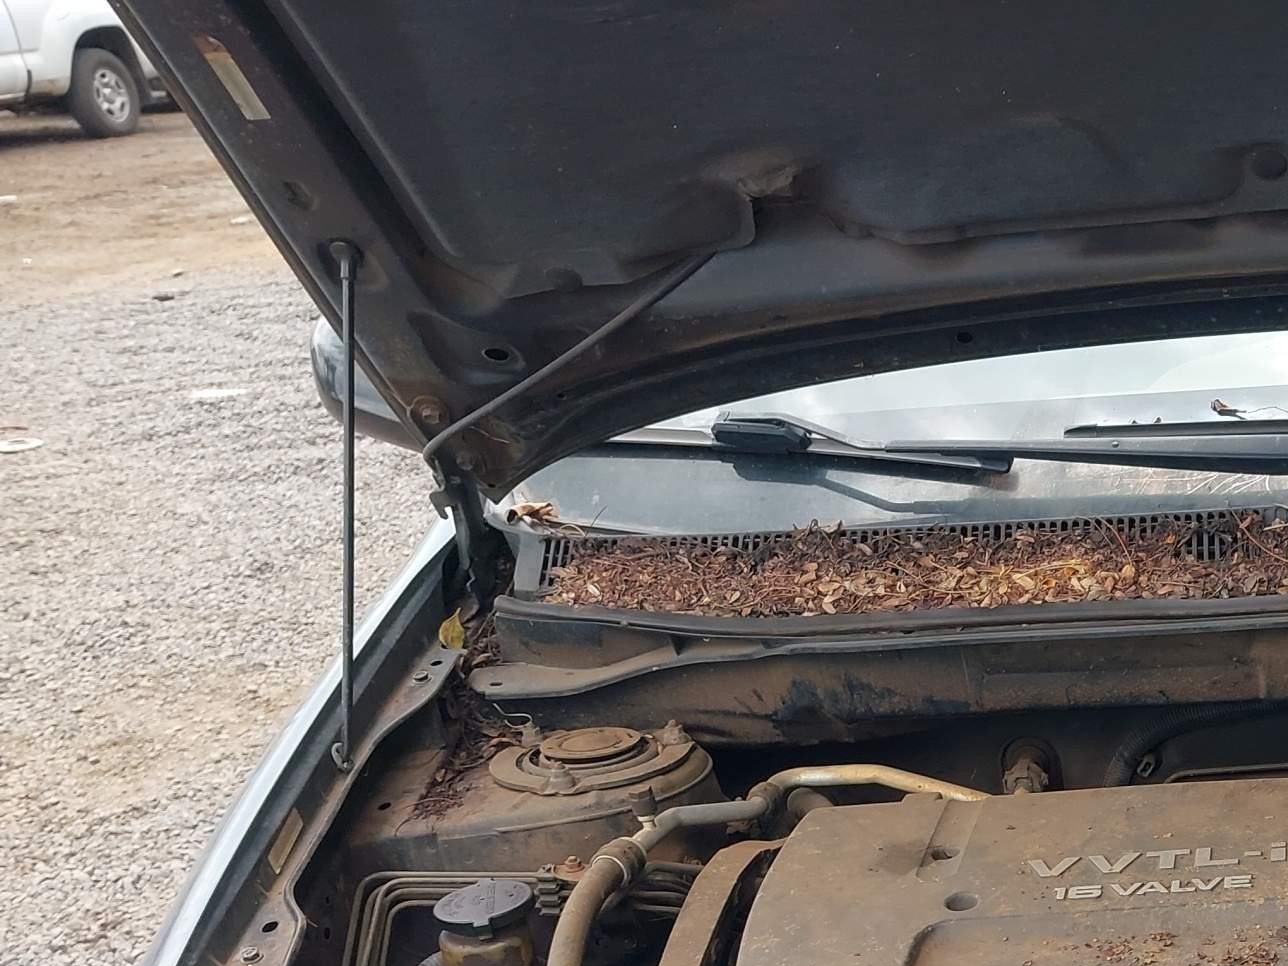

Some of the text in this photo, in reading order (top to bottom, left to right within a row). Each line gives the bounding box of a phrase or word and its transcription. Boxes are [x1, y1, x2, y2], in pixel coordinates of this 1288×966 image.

[1027, 841, 1288, 878] VVTL-i
[1053, 874, 1256, 901] 16 VALVE
